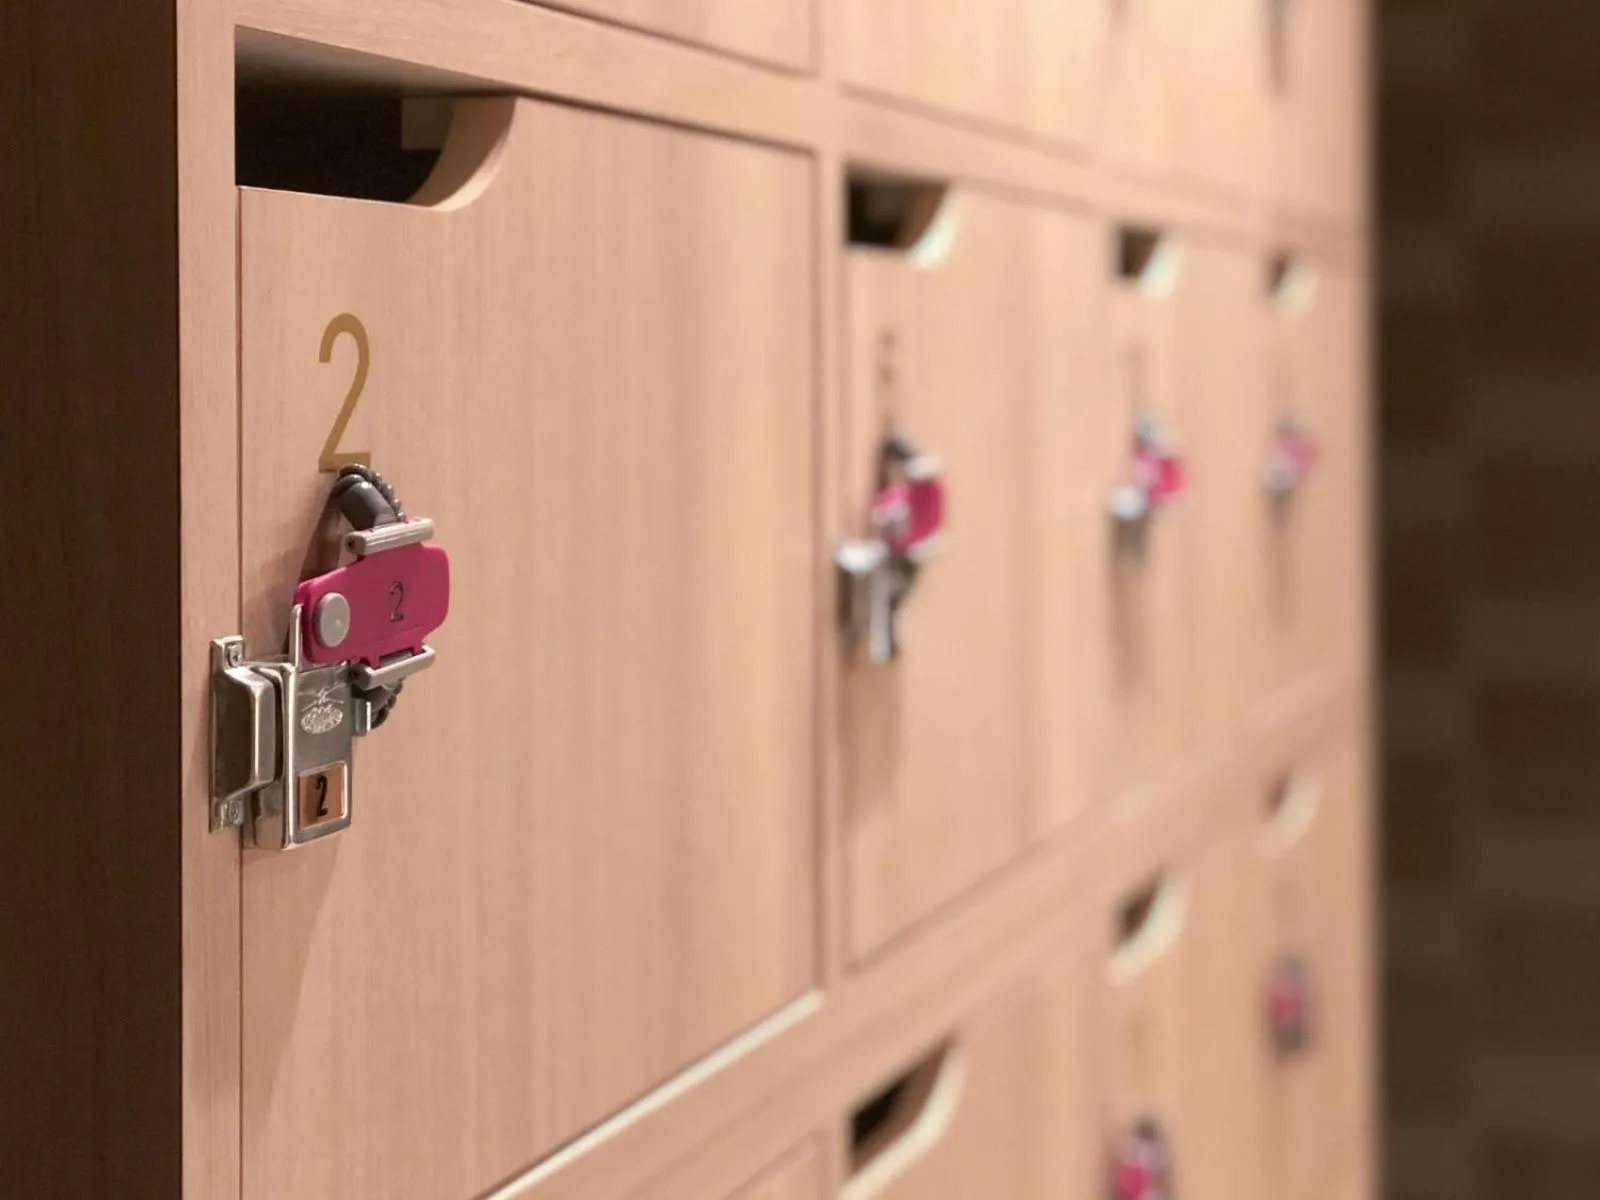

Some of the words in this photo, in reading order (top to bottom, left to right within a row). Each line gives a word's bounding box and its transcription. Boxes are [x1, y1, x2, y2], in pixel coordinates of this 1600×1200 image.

[318, 313, 371, 474] 2
[389, 580, 405, 623] 2
[314, 775, 329, 817] 2
